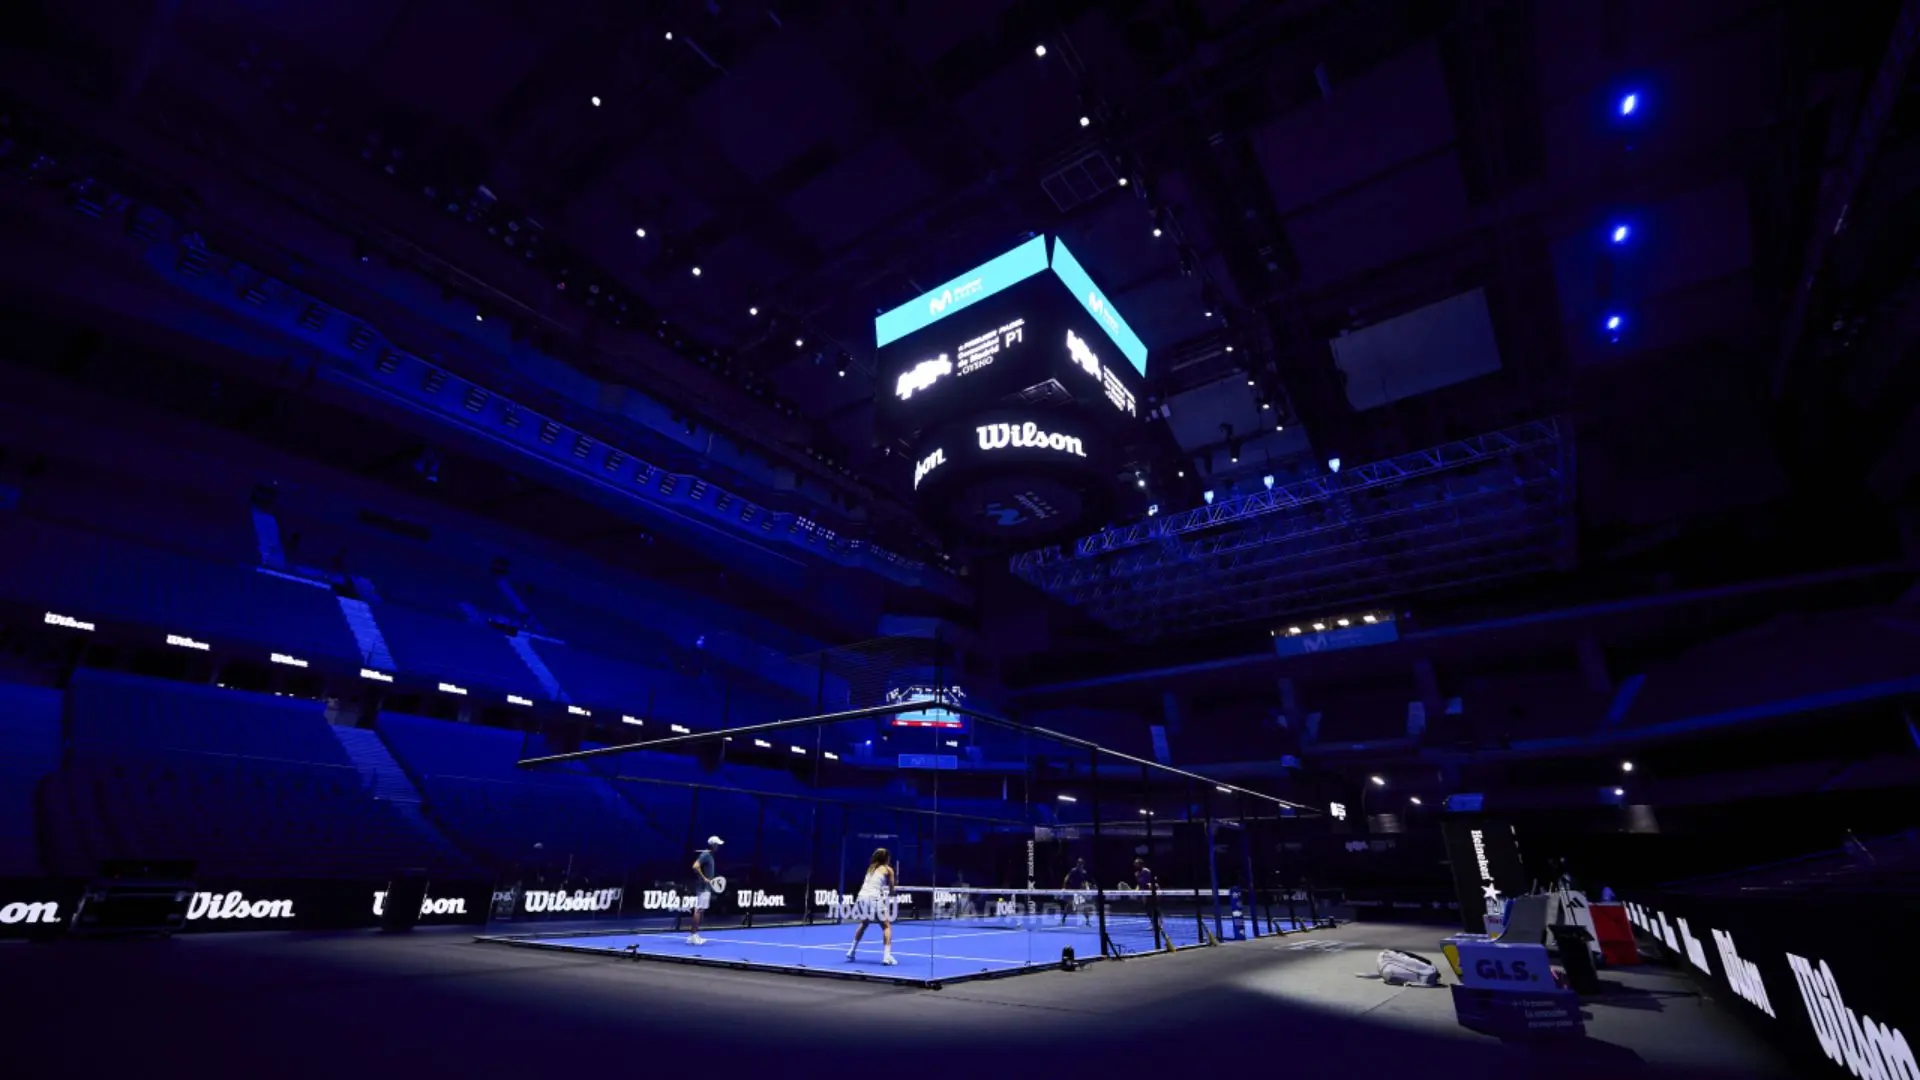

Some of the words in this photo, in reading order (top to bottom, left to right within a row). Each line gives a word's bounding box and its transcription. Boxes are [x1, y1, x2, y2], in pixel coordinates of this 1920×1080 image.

[1005, 327, 1023, 349] P1
[976, 421, 1087, 458] Wilson
[1470, 829, 1492, 881] Heineken
[737, 889, 787, 908] Wilson
